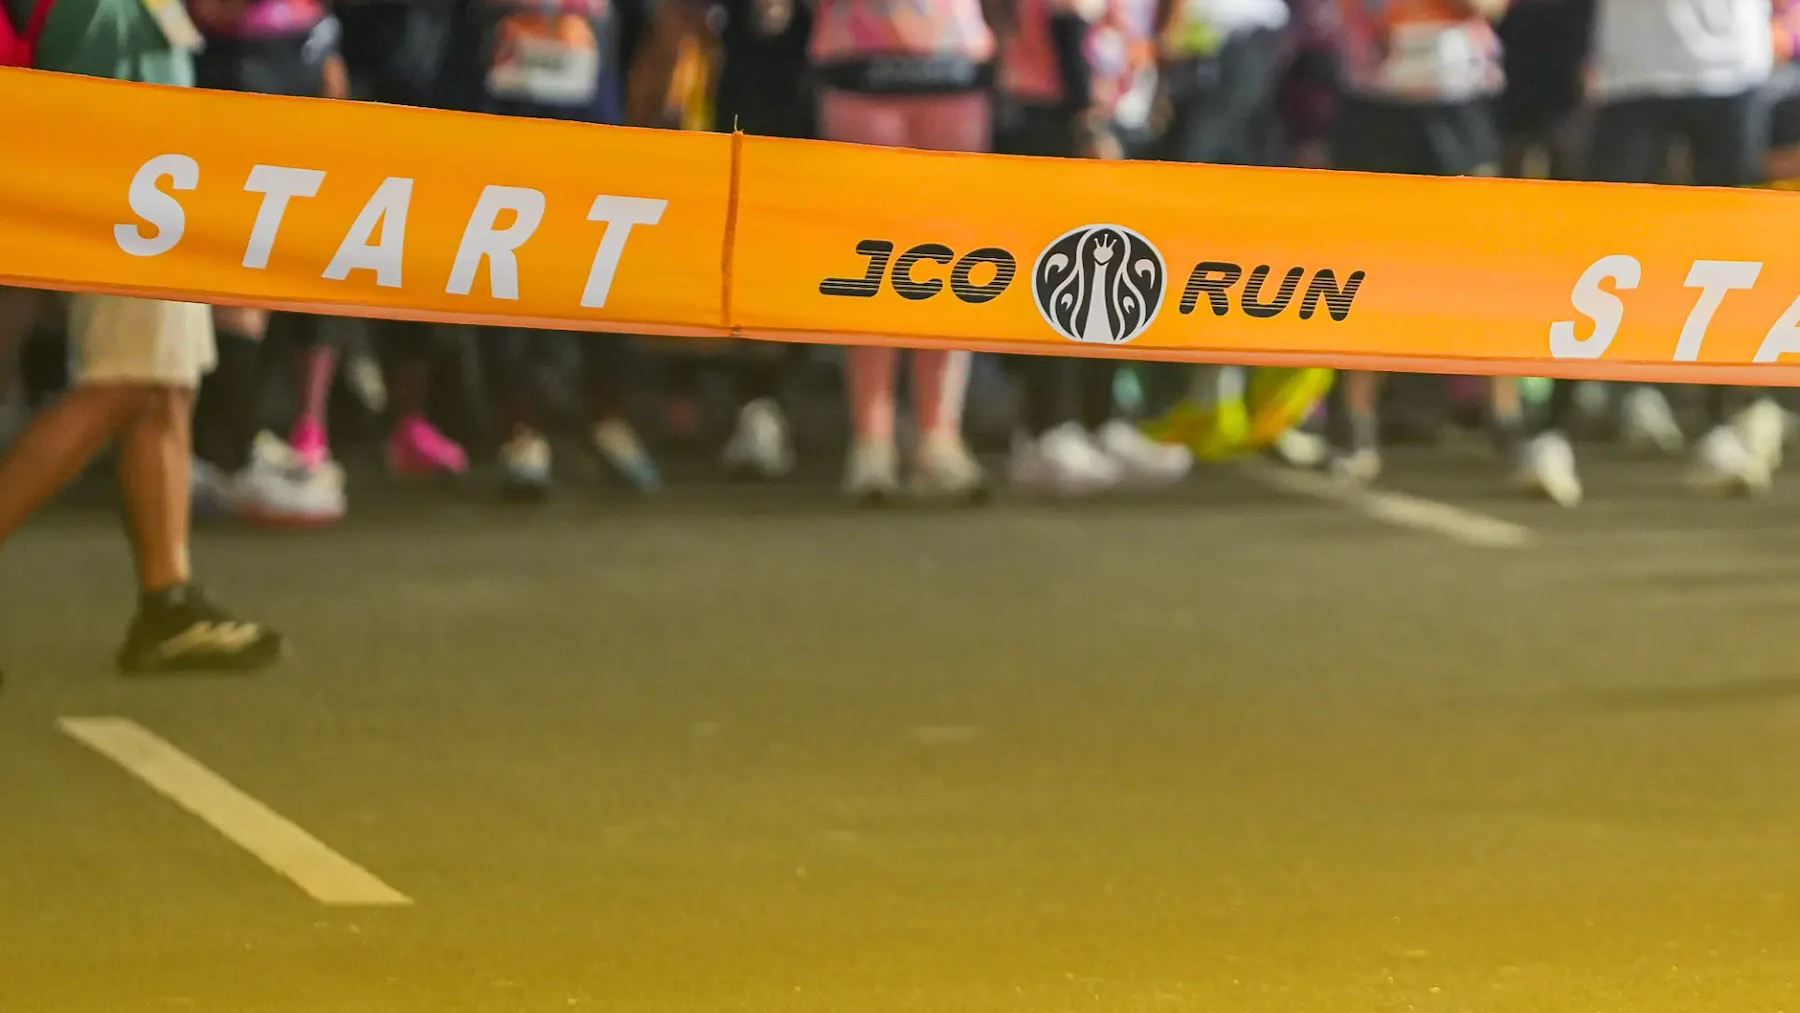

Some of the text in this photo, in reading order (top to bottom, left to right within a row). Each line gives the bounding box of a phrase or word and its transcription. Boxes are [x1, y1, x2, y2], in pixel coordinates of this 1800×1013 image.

[114, 154, 668, 308] START
[819, 240, 1365, 321] JCO RUN
